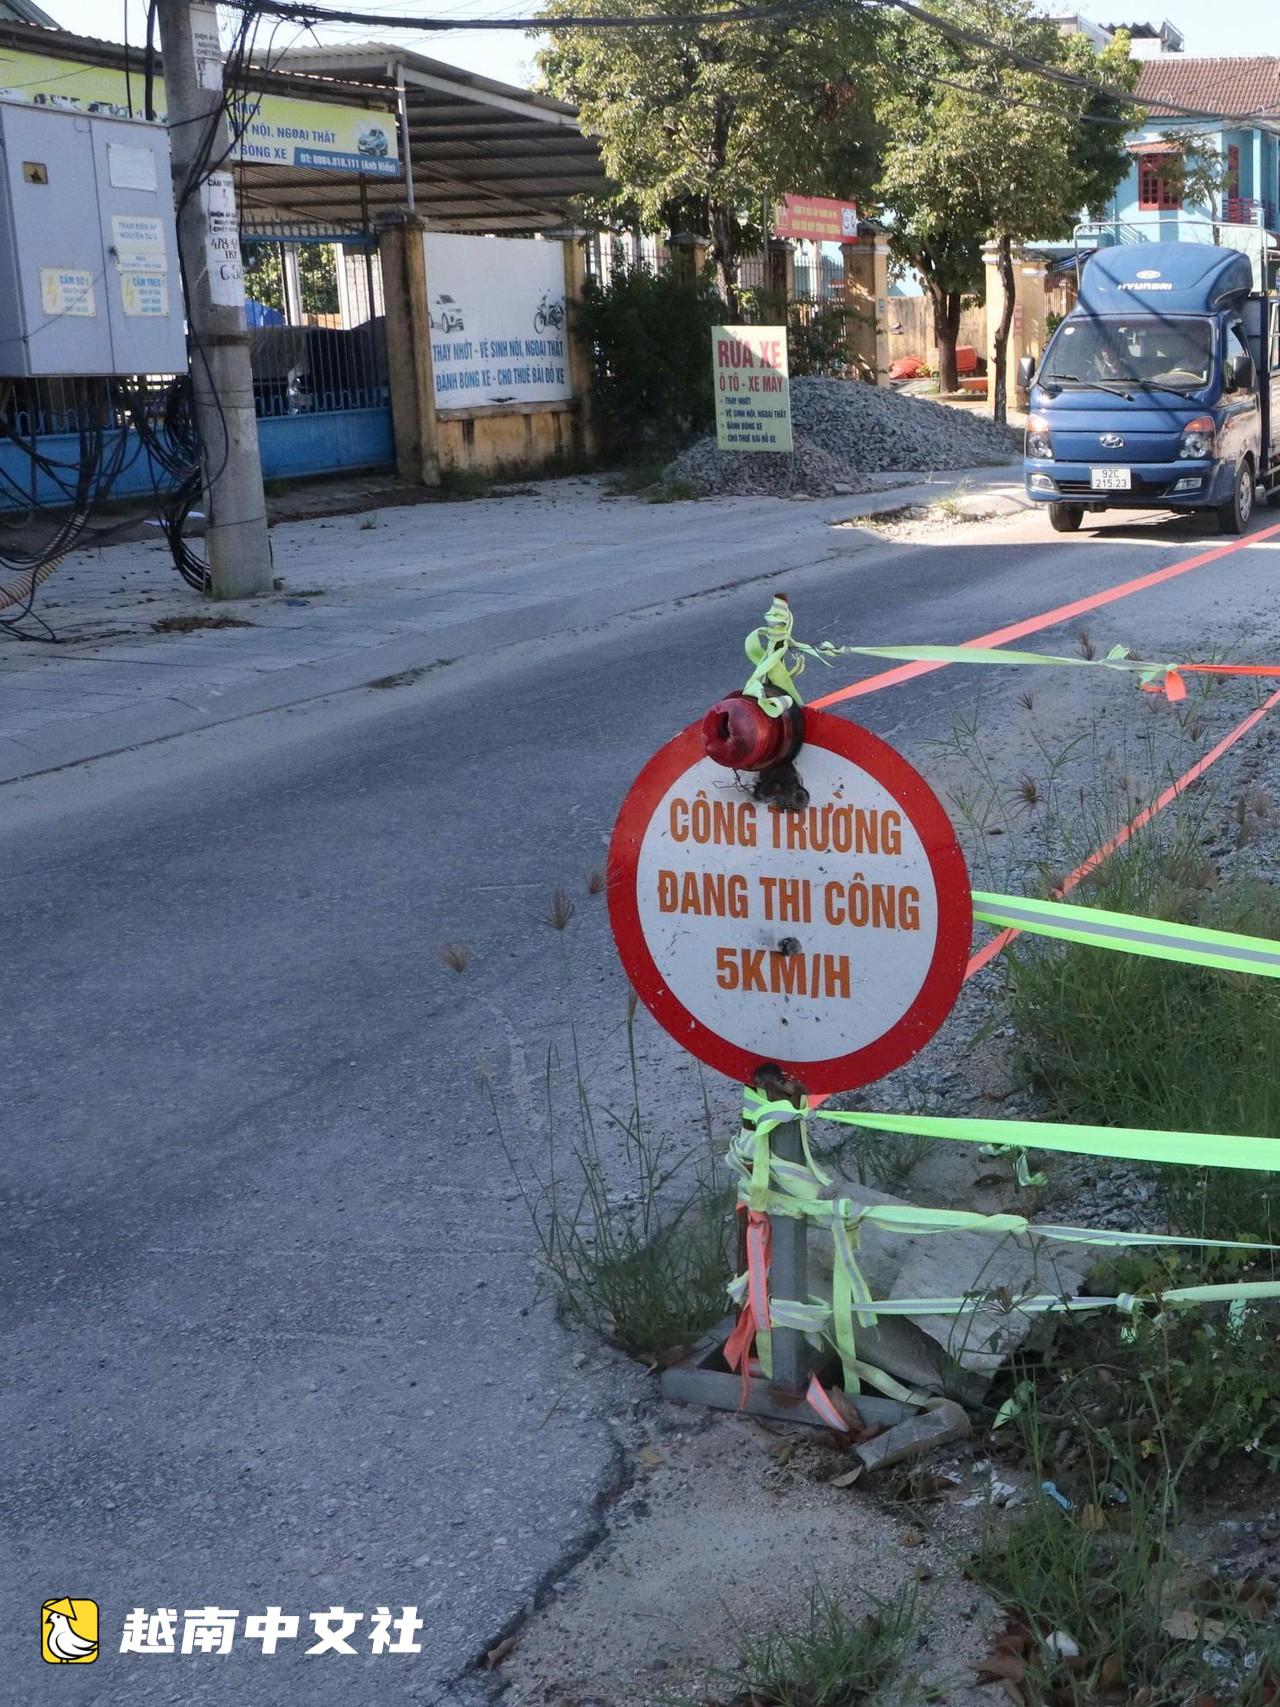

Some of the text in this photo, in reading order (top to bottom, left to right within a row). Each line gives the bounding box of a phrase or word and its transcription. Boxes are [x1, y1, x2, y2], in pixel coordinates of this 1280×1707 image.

[277, 126, 310, 143] NGOẠI
[274, 147, 288, 160] XE
[1117, 282, 1173, 291] HYUNDAI
[433, 342, 451, 363] THAY
[490, 339, 508, 359] SINH
[760, 340, 781, 369] XE
[482, 369, 491, 387] XE
[497, 367, 511, 386] CHO
[555, 367, 565, 385] XE
[719, 372, 726, 392] Ô
[728, 372, 739, 392] TÔ
[748, 375, 760, 393] XE
[762, 372, 783, 393] MÁY
[1102, 469, 1119, 479] 92C
[669, 790, 757, 848] CÔNG
[657, 869, 920, 931] ĐANG THI CÔNG
[716, 946, 852, 1000] 5KM/H
